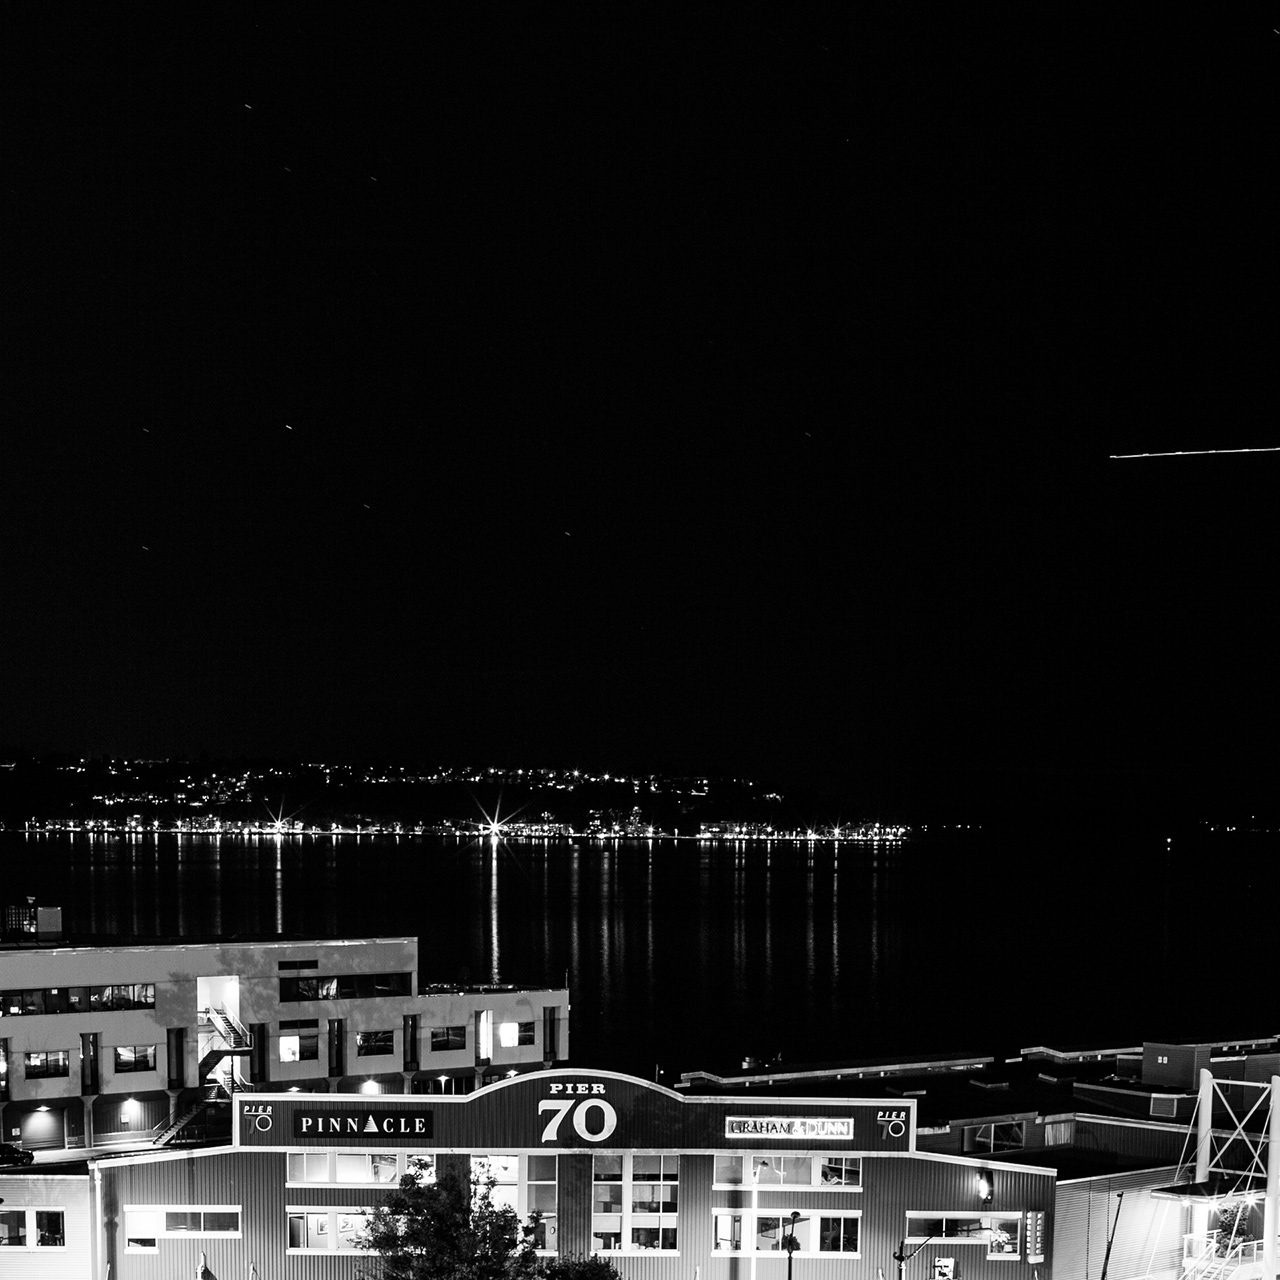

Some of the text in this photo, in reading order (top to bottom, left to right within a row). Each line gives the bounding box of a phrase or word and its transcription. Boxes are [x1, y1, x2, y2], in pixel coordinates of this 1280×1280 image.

[549, 1083, 606, 1094] PIER
[243, 1105, 273, 1114] PIER
[877, 1111, 906, 1119] PIER
[244, 1115, 273, 1135] 70
[301, 1115, 426, 1133] PINNACLE
[538, 1098, 618, 1143] 70
[730, 1120, 849, 1136] GRAHAM & DUNN
[877, 1120, 906, 1140] 70
